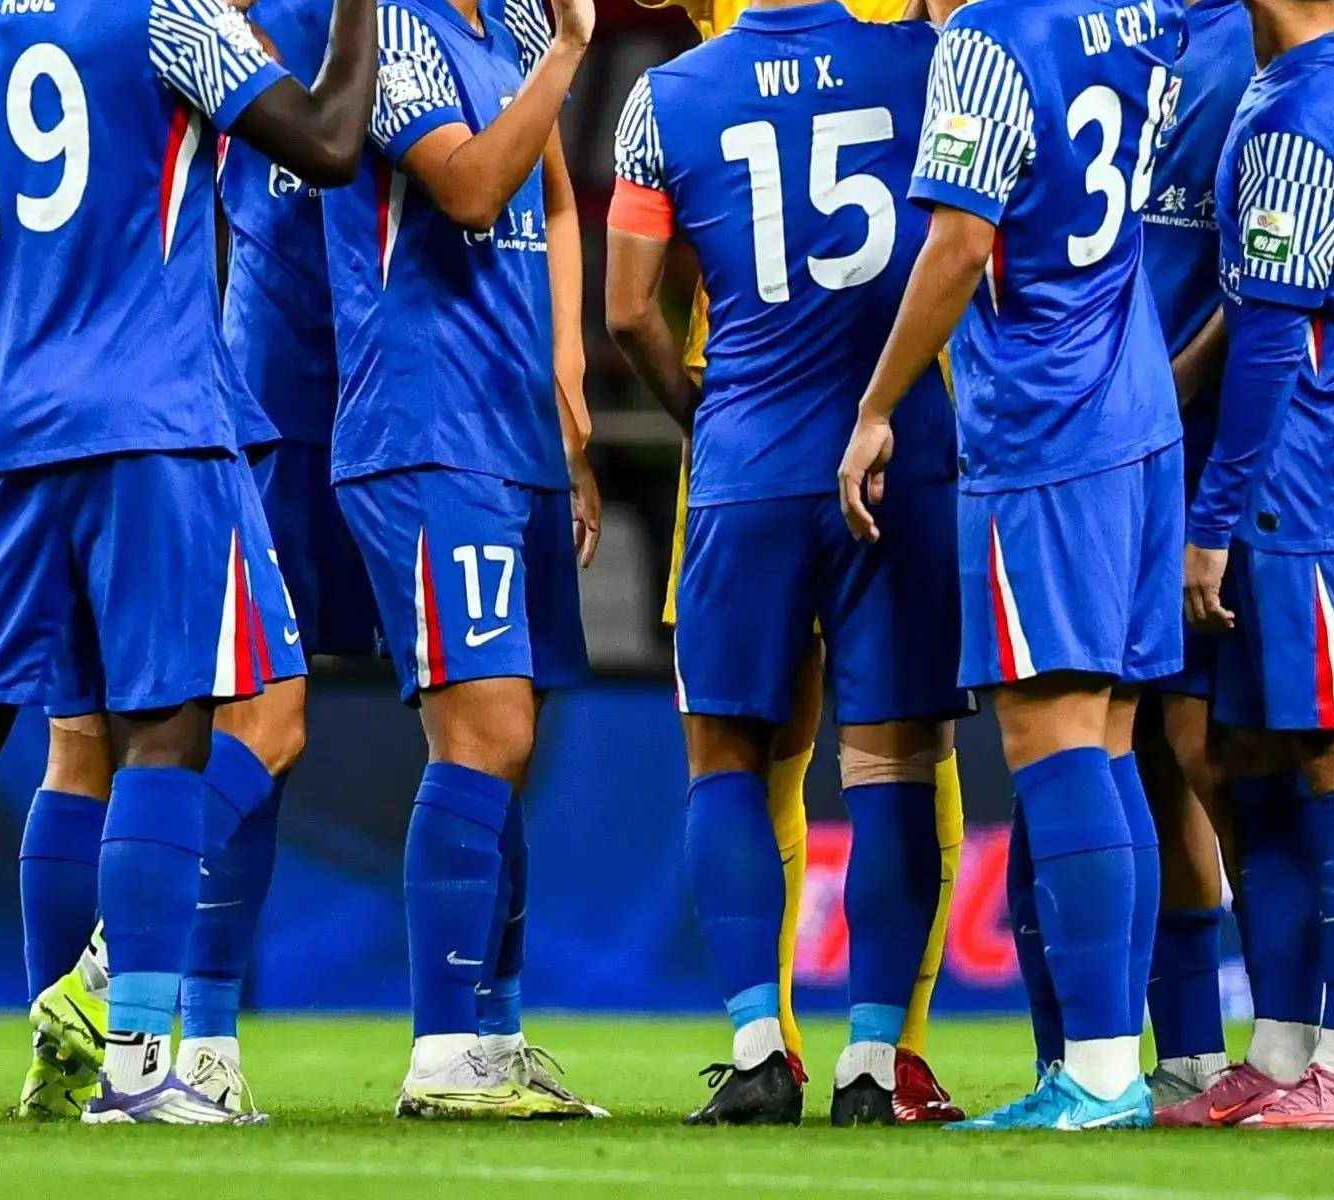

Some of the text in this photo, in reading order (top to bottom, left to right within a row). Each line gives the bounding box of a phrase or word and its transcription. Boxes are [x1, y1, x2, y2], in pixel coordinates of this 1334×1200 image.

[1078, 12, 1111, 56] LIU
[754, 55, 844, 98] WU X.
[720, 106, 897, 304] 15
[453, 544, 515, 620] 17
